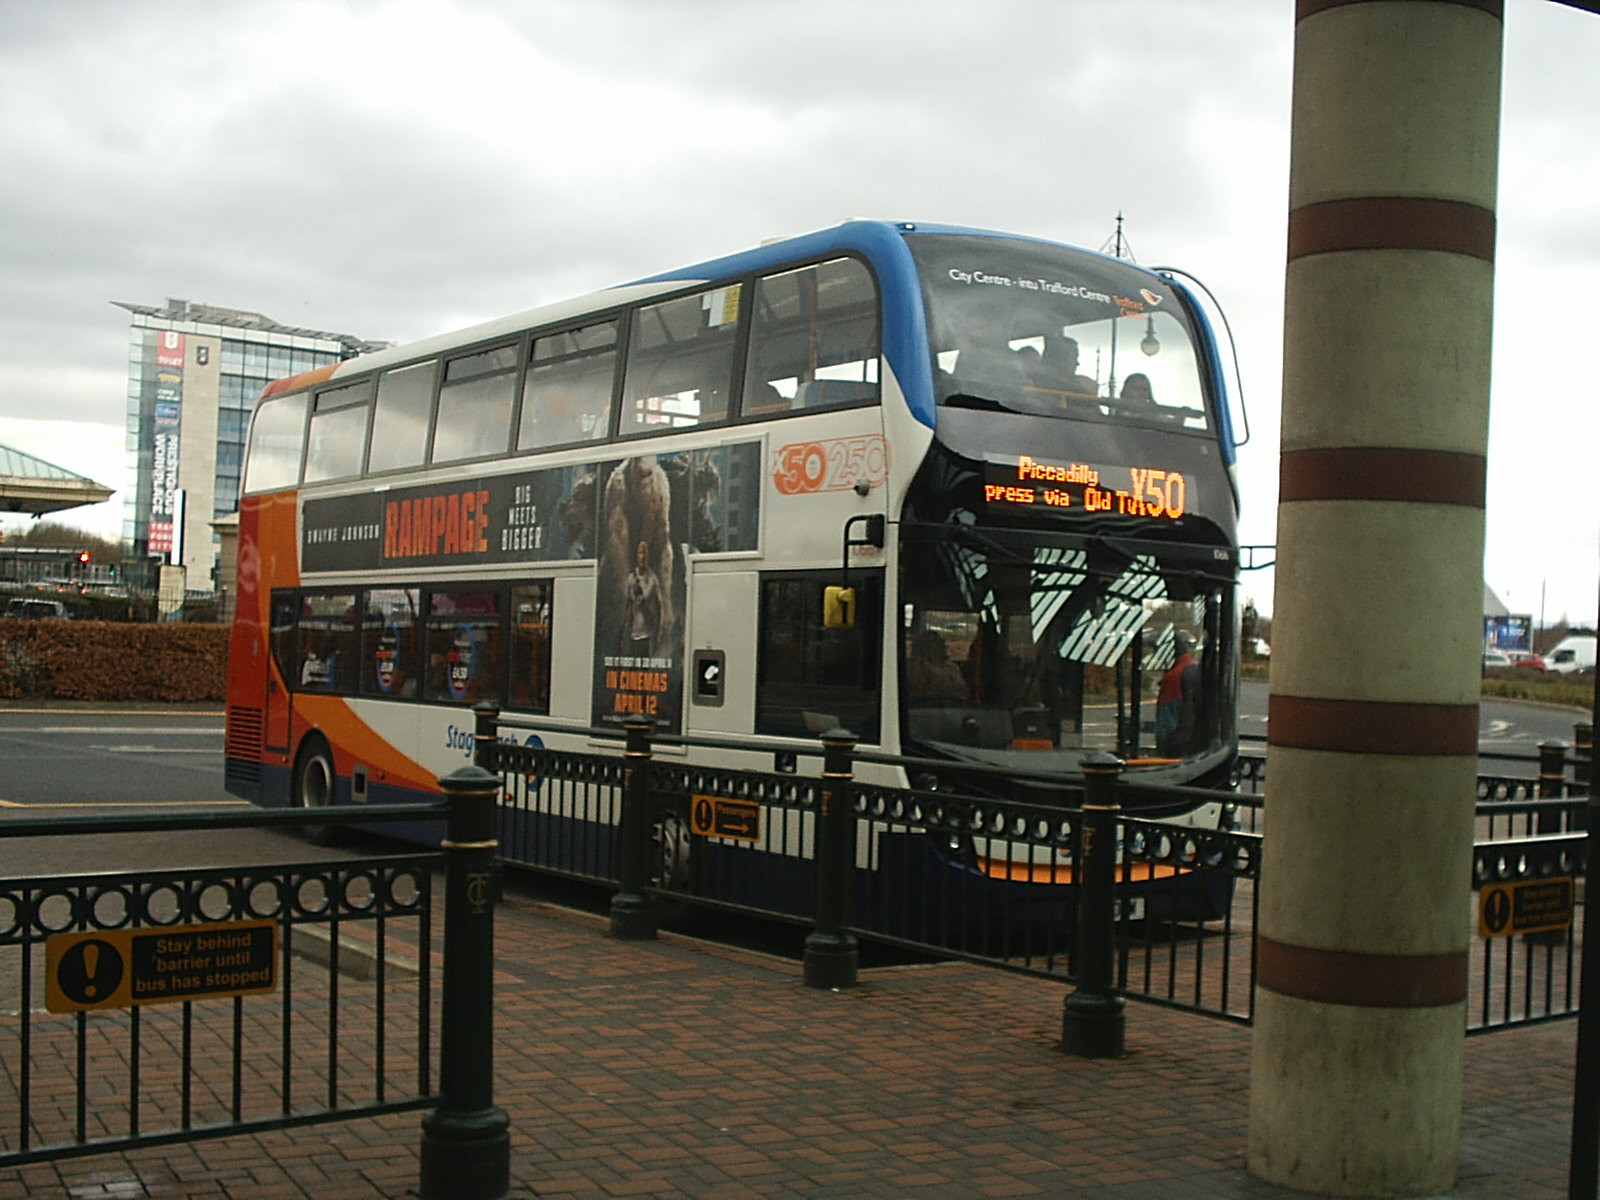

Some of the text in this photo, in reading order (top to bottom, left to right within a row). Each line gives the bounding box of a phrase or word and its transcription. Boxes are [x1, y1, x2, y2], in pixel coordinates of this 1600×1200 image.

[949, 268, 972, 285] City
[973, 270, 1012, 287] Centre
[1017, 276, 1039, 291] intu
[1037, 278, 1079, 297] Trafford
[1079, 286, 1111, 304] Centre
[152, 433, 165, 515] WORKPLACE
[1018, 455, 1099, 487] Piccadilly
[515, 484, 531, 505] BIG
[984, 484, 1035, 504] press
[1044, 488, 1070, 507] via
[1131, 467, 1185, 519] X50
[307, 490, 490, 559] DWAYNE JOHNSON RAMPAGE
[508, 505, 537, 526] MEETS
[501, 526, 542, 551] BIGGER
[606, 671, 667, 693] IN CINEMAS
[614, 693, 657, 715] APRIL 12
[156, 933, 252, 956] Stay behind
[156, 950, 251, 973] barrier until
[136, 966, 270, 993] bus has stopped
